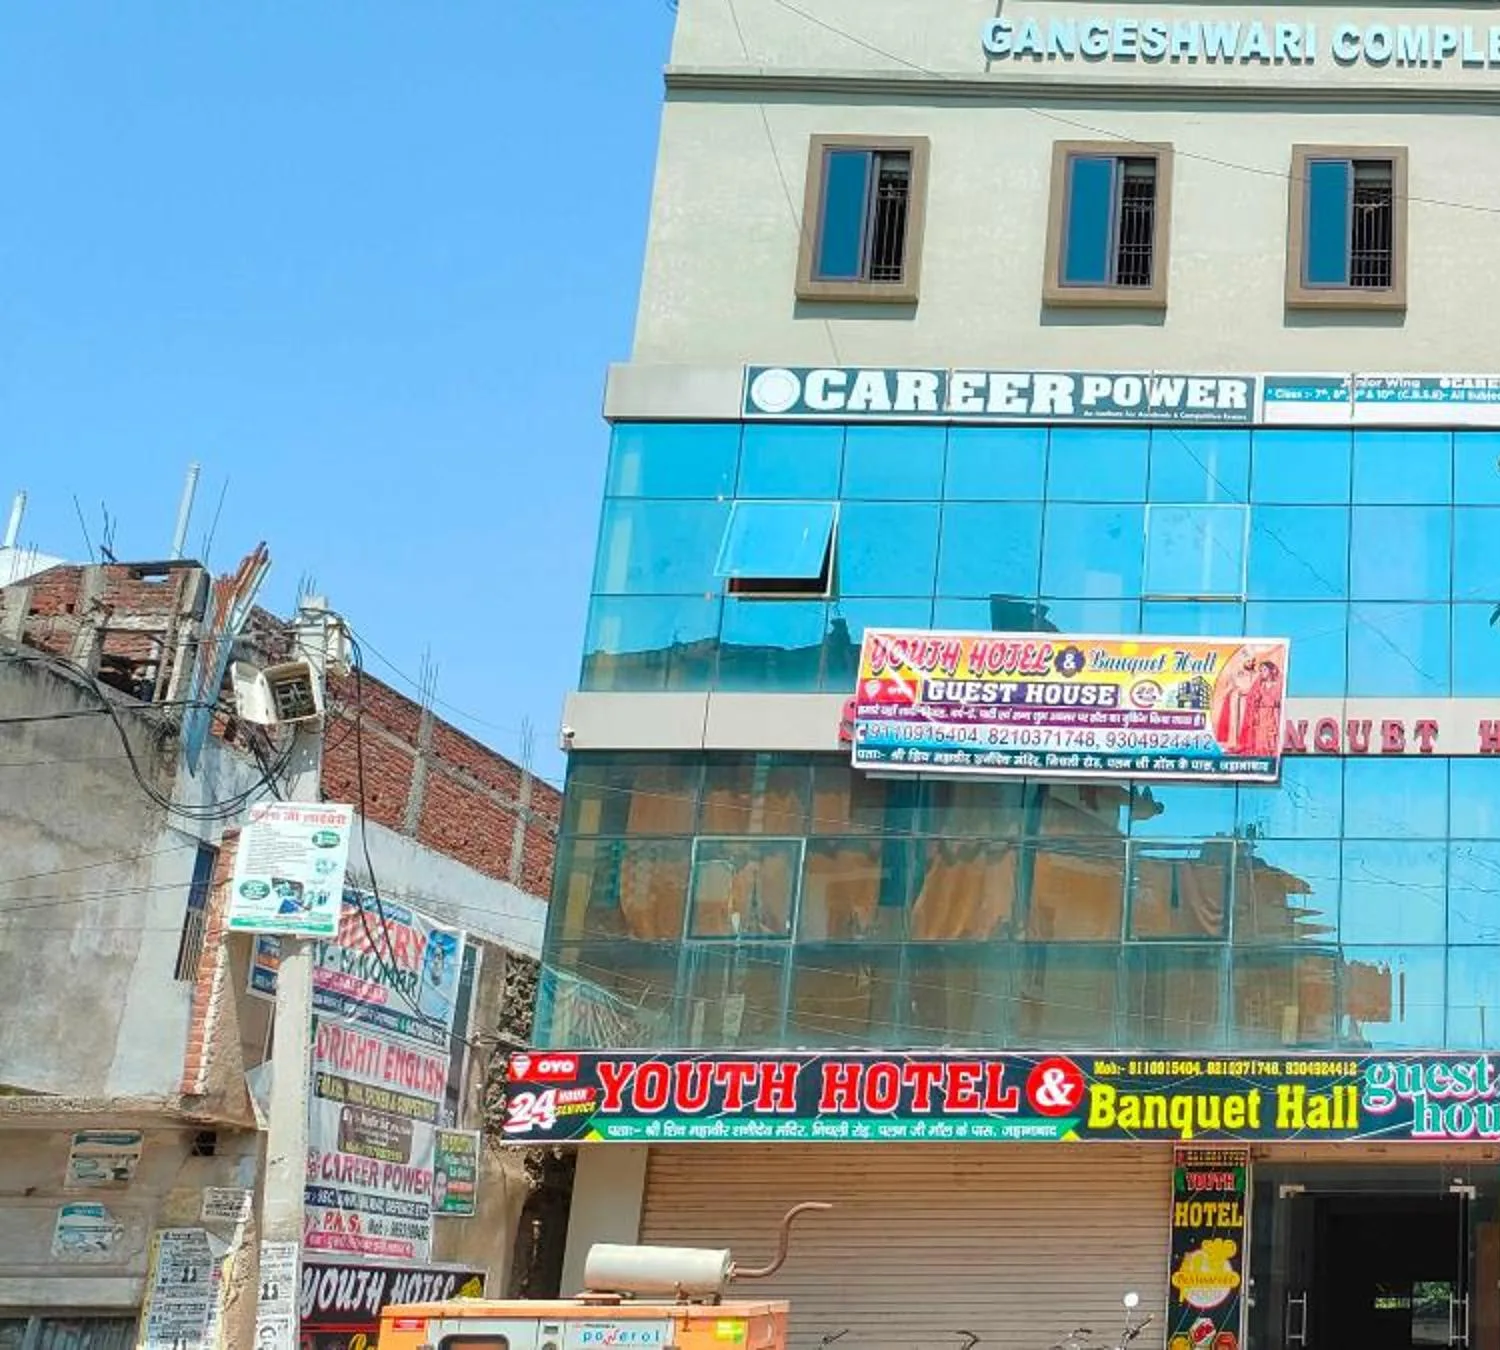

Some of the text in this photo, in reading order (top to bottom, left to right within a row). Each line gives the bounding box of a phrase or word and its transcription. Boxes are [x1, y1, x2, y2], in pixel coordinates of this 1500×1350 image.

[980, 18, 1316, 65] GANGESHWARI
[804, 370, 1248, 414] CAREER POWER
[871, 638, 1217, 678] YOUTH HOTEL & Banquet Hall
[928, 680, 1018, 704] GUEST
[1025, 682, 1115, 707] HOUSE
[987, 728, 1100, 751] 8210371748,
[1105, 731, 1212, 751] 9304924412
[1281, 718, 1439, 754] NQUET
[316, 1022, 446, 1096] DRISHTI ENGLISH
[537, 1058, 575, 1073] OYO
[596, 1061, 1075, 1113] YOUTH HOTEL &
[1362, 1054, 1497, 1113] guest
[506, 1089, 557, 1131] 24
[1087, 1083, 1359, 1140] Banquet Hall
[321, 1153, 380, 1189] CAREER
[382, 1163, 434, 1197] POWER
[1185, 1171, 1236, 1192] YOUTH
[1174, 1201, 1244, 1227] HOTEL
[301, 1267, 387, 1319] YOUTH
[582, 1328, 660, 1346] powerol
